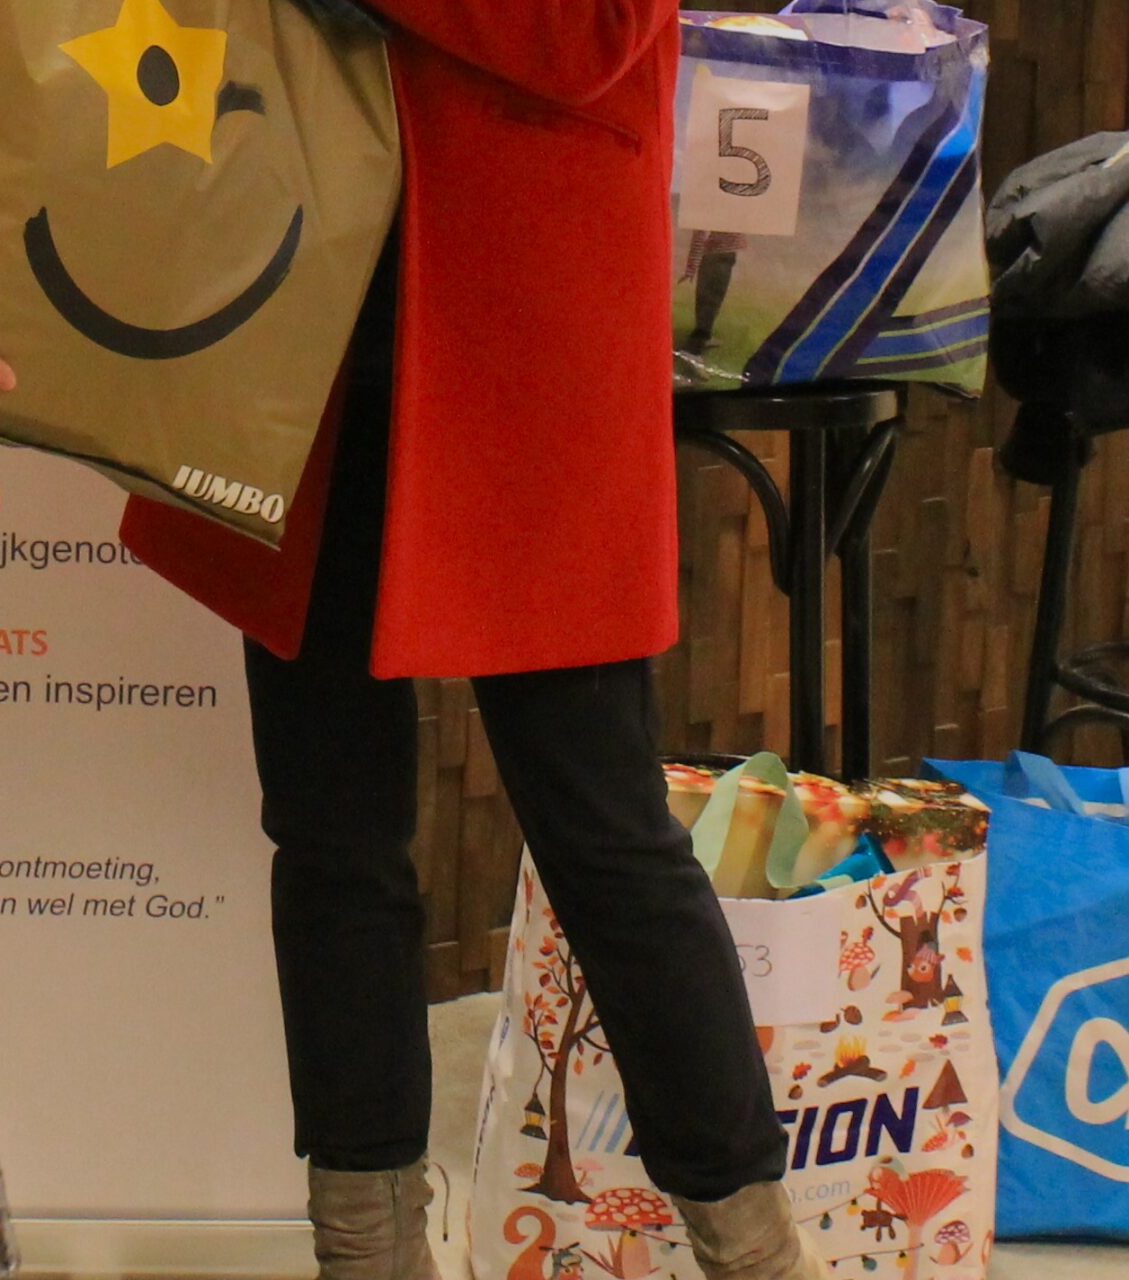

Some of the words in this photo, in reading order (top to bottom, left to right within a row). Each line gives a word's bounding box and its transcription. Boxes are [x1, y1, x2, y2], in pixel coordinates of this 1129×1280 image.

[718, 107, 771, 197] 5
[172, 464, 284, 523] JUMBO
[45, 674, 217, 711] inspireren
[28, 893, 74, 916] wel
[82, 894, 135, 917] met
[145, 894, 225, 919] God."
